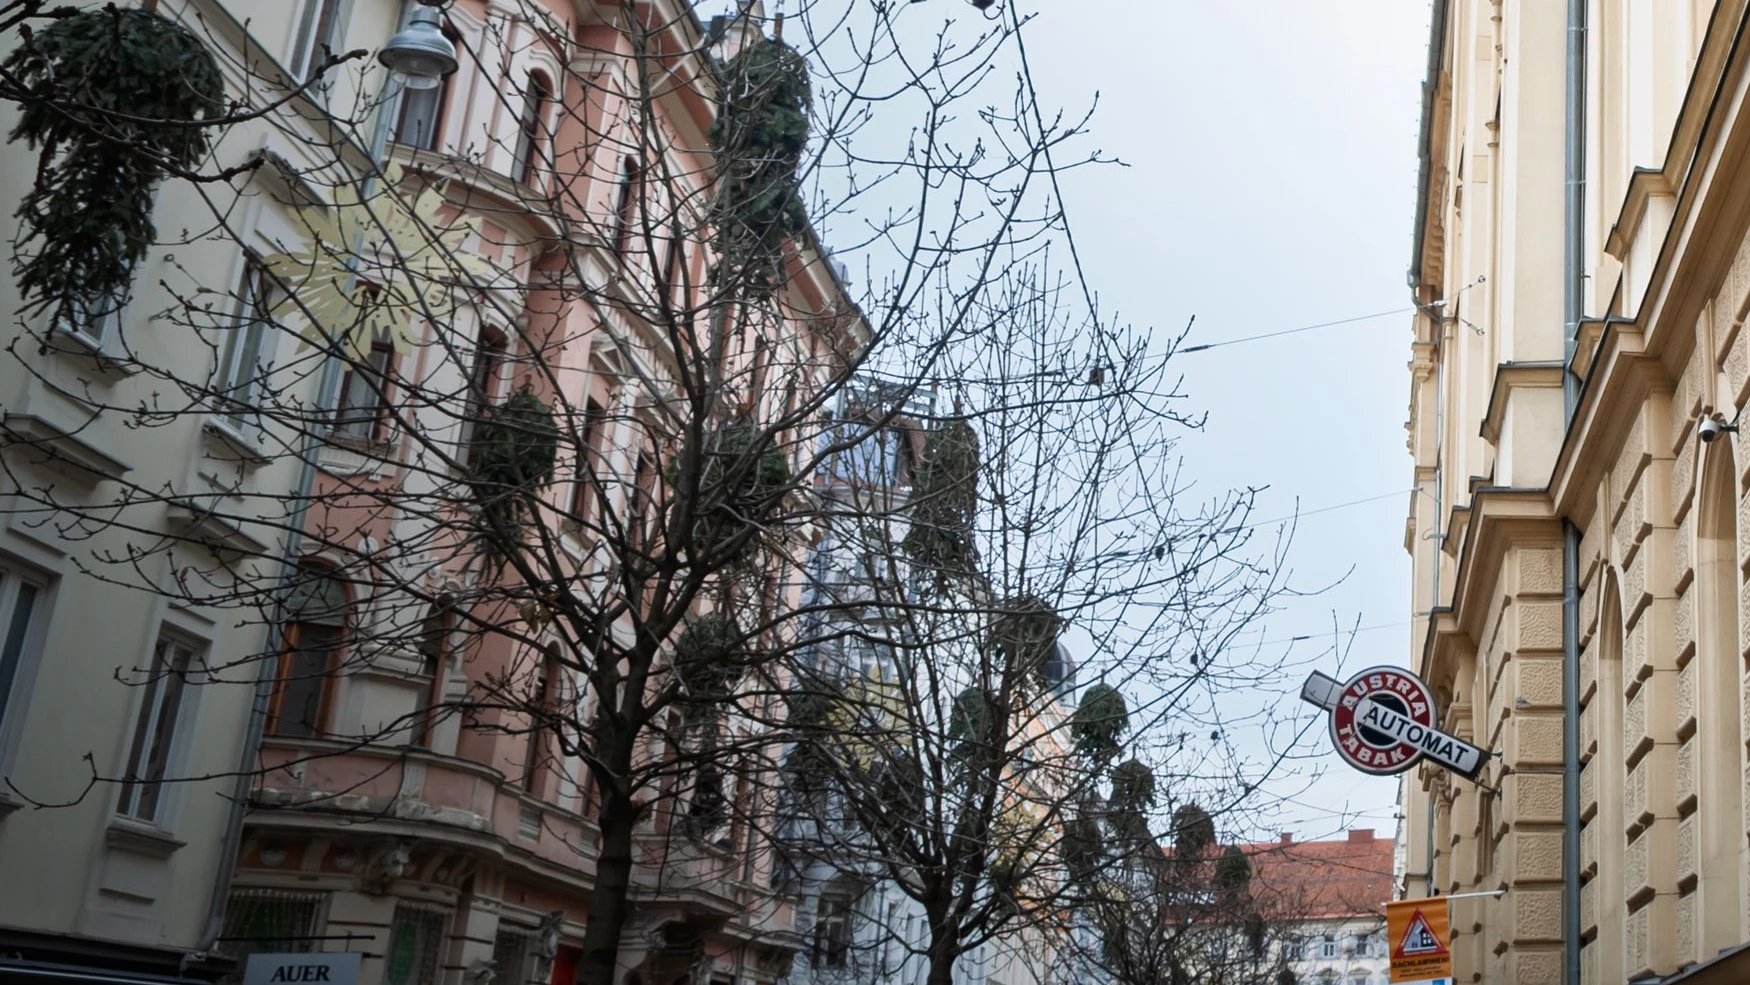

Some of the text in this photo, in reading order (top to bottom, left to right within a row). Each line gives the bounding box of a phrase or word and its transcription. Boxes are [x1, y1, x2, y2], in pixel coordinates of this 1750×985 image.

[1342, 674, 1426, 717] AUSTRIA
[1340, 723, 1406, 765] TABAK
[1362, 706, 1469, 764] AUTOMAT
[270, 965, 330, 982] AUER
